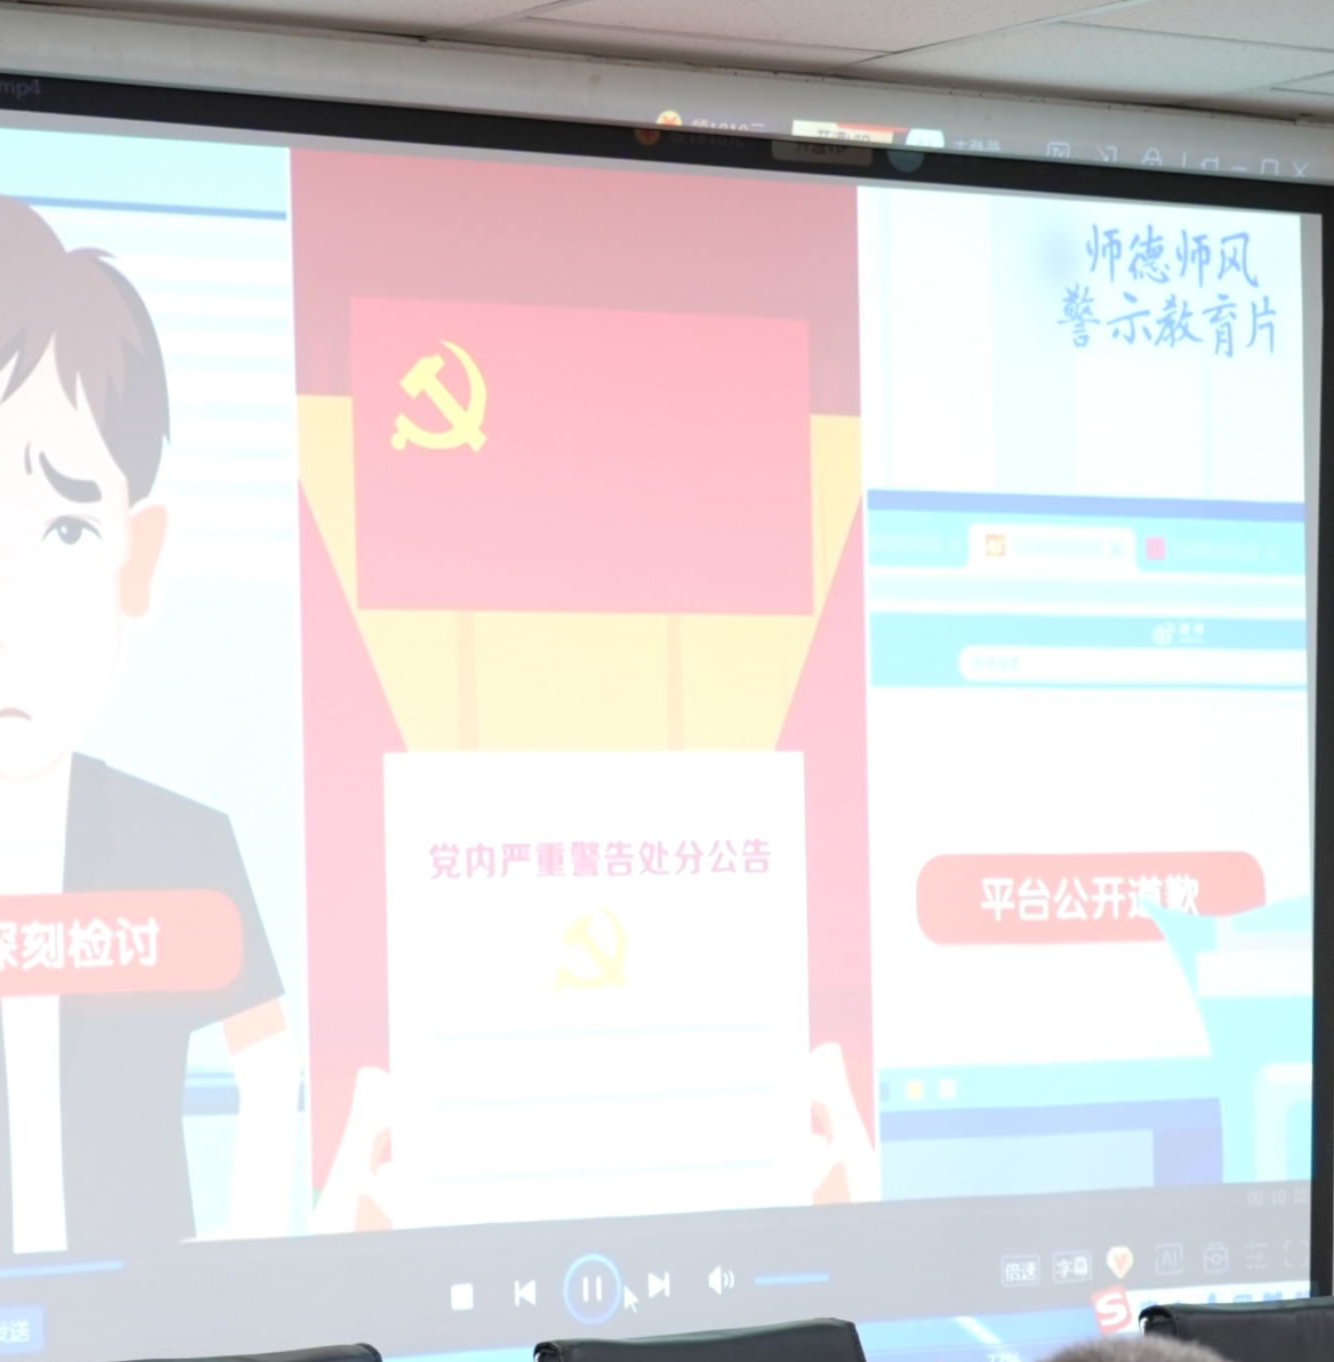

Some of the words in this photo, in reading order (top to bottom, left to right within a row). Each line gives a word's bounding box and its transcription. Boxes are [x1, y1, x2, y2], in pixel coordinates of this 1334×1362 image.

[1085, 223, 1259, 289] 师德师风
[1057, 283, 1277, 359] 警示教育片
[428, 837, 772, 882] 党内严重警告处分公告
[980, 873, 1200, 922] 平台公开道歉
[1005, 1260, 1038, 1283] 倍速
[1055, 1255, 1089, 1279] 字幕
